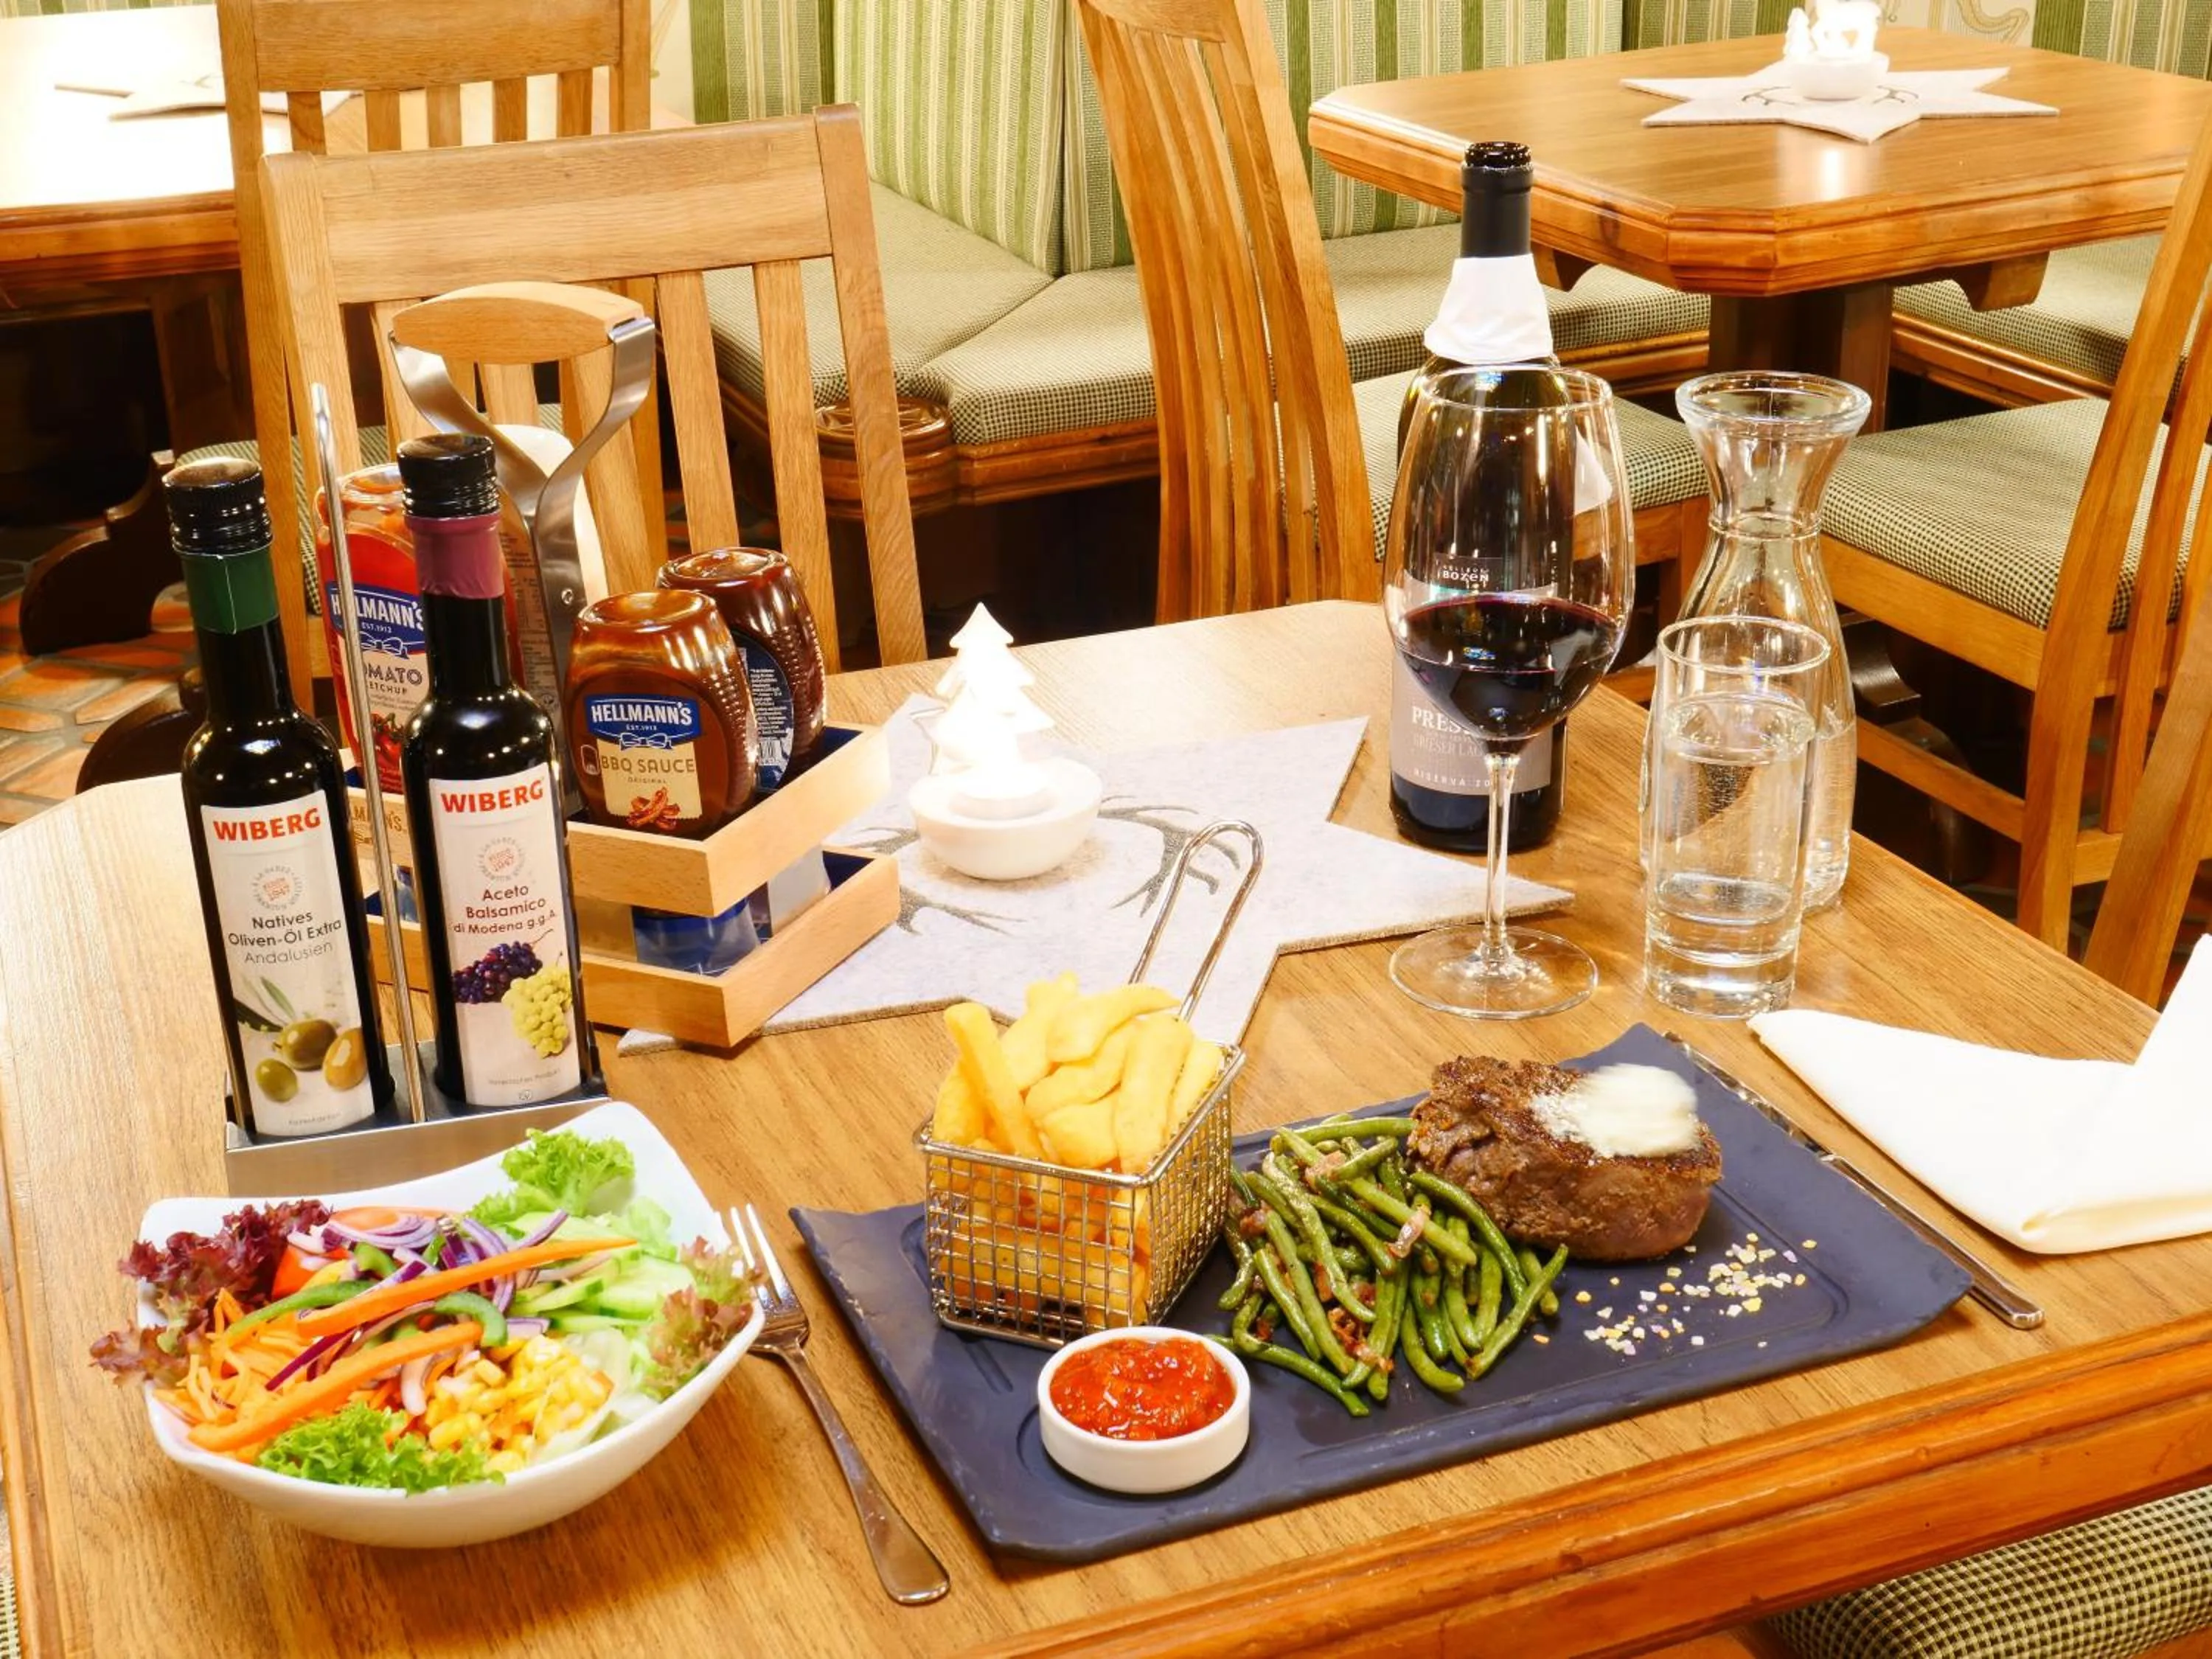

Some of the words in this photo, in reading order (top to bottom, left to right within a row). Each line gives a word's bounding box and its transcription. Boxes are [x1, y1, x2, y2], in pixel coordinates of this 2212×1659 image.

[331, 594, 424, 631] HLMANN'S
[369, 684, 407, 695] ETCHUP
[591, 702, 692, 726] HELLMANN'S
[601, 755, 632, 774] BBQ
[637, 758, 695, 773] SAUCE
[441, 779, 543, 813] WIBERG
[213, 807, 321, 841] WIBERG
[482, 886, 529, 902] Aceto
[465, 897, 546, 919] Balsamico
[251, 911, 313, 929] Natives
[453, 922, 465, 933] di
[468, 919, 523, 934] Modena
[228, 929, 302, 947] Oliven-Öl
[308, 919, 341, 939] Extra
[244, 942, 333, 965] Andalusien
